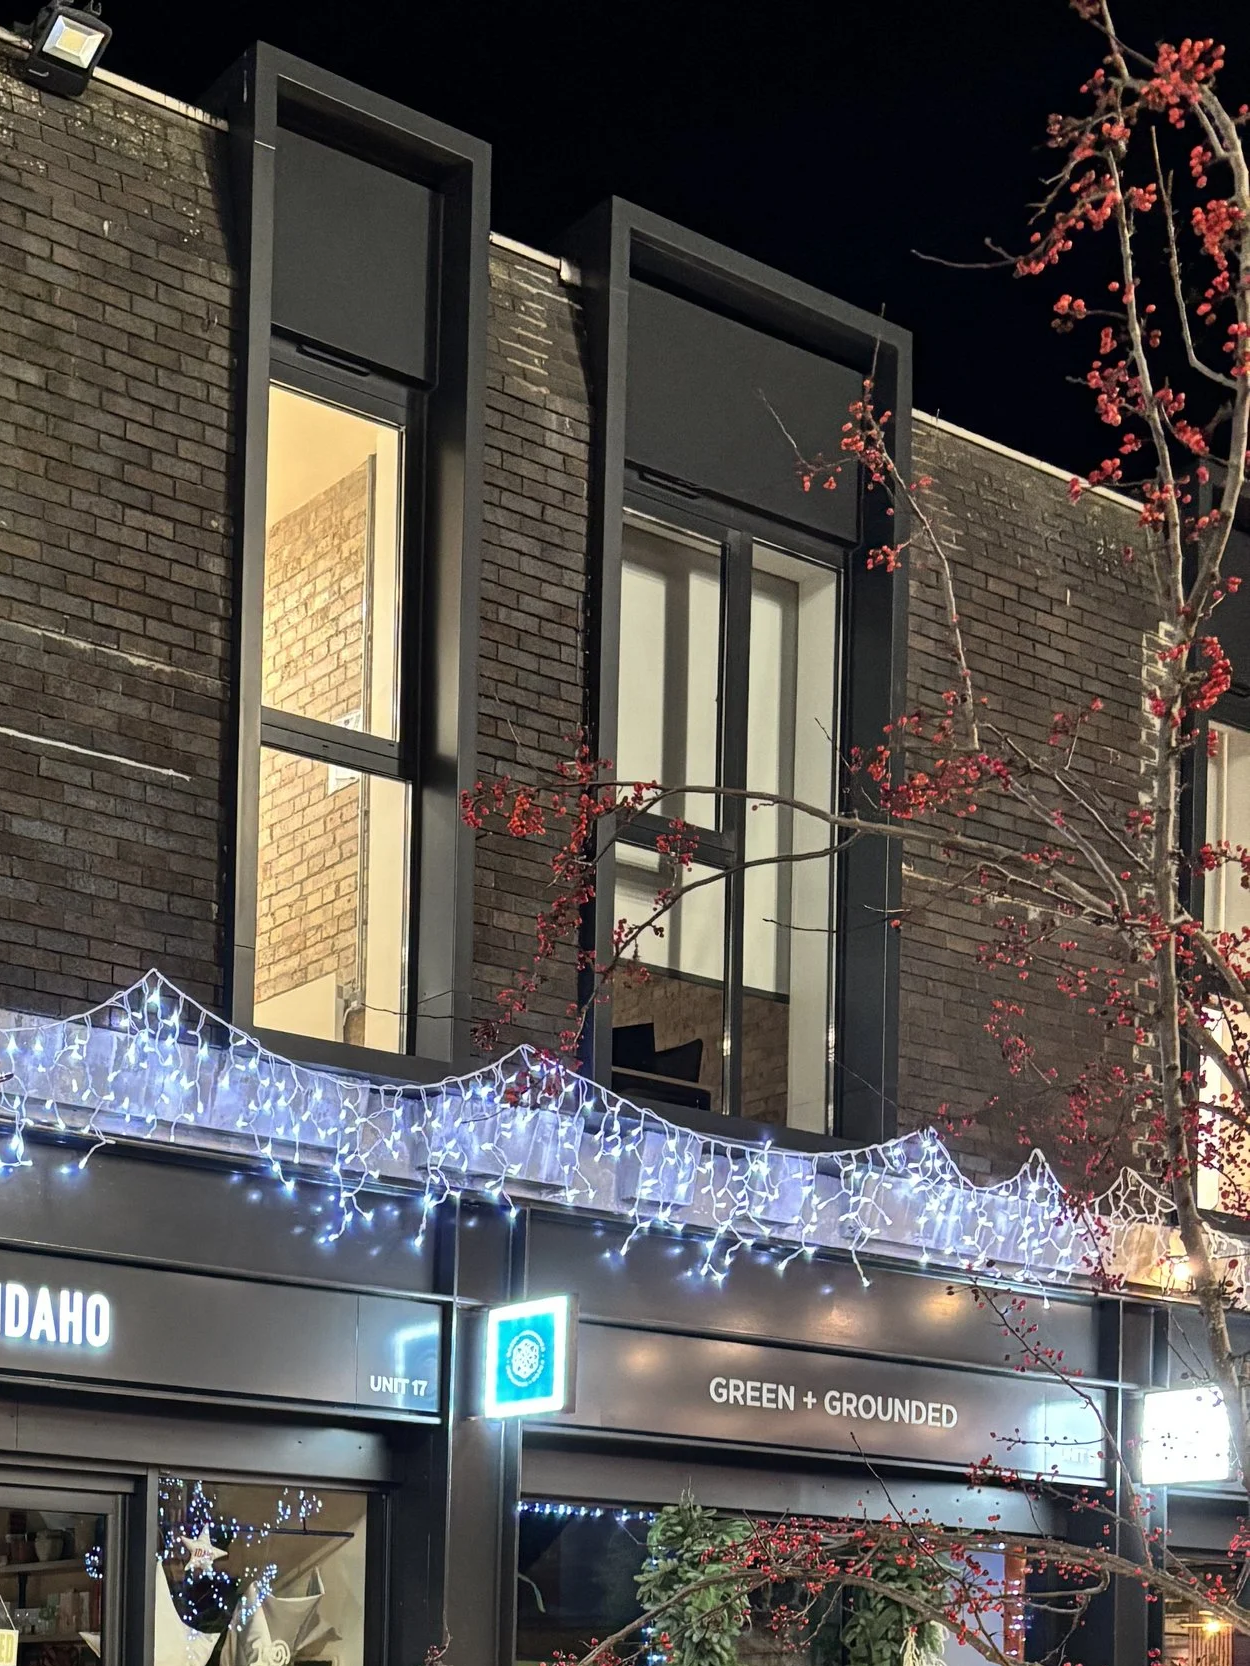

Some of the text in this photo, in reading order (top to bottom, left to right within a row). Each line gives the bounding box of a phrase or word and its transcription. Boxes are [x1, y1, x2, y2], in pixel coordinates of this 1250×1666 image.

[370, 1374, 428, 1397] UNIT 17
[709, 1377, 958, 1428] GREEN + GROUNDED
